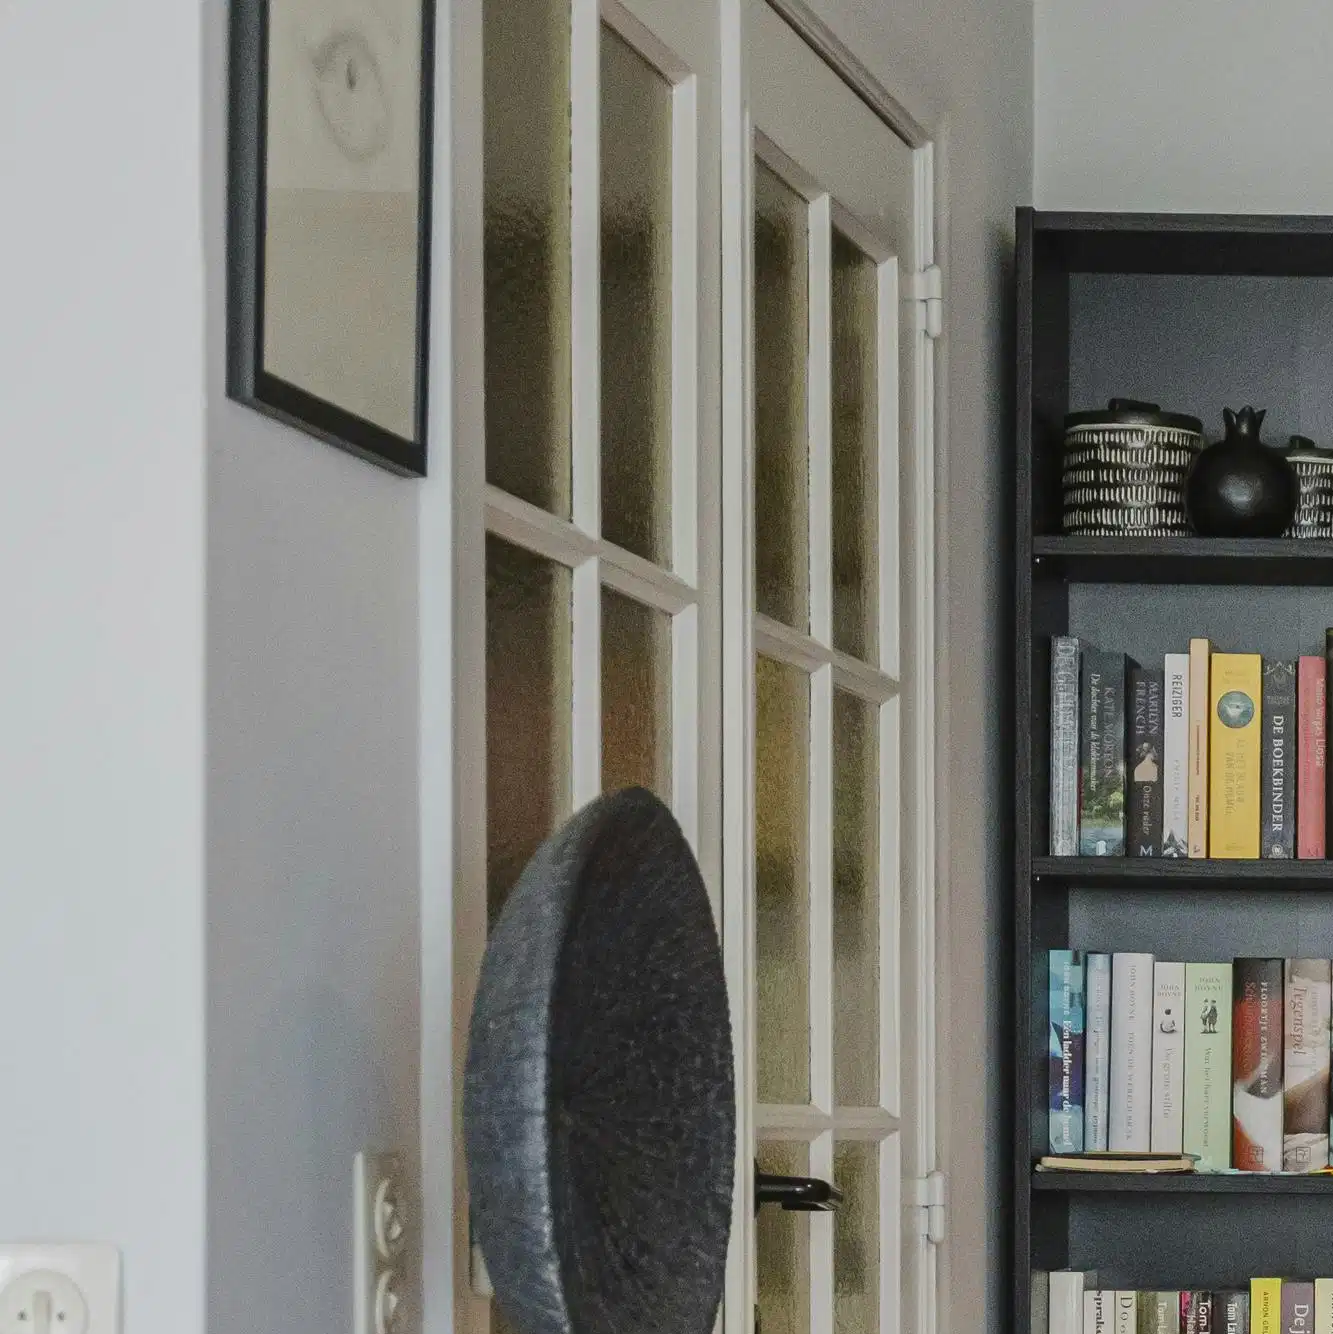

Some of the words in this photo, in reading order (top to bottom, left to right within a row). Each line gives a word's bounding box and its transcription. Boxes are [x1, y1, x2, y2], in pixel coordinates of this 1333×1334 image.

[1172, 675, 1183, 719] REIZIGER
[1272, 716, 1284, 733] DE
[1272, 739, 1284, 832] BOEKBINDER
[1292, 987, 1307, 1054] Tegenspel
[1062, 1041, 1072, 1074] ladder
[1062, 1076, 1070, 1099] naar
[1062, 1101, 1072, 1112] de
[1200, 1301, 1209, 1324] Tom
[1295, 1304, 1308, 1326] De
[1187, 1315, 1195, 1334] Het
